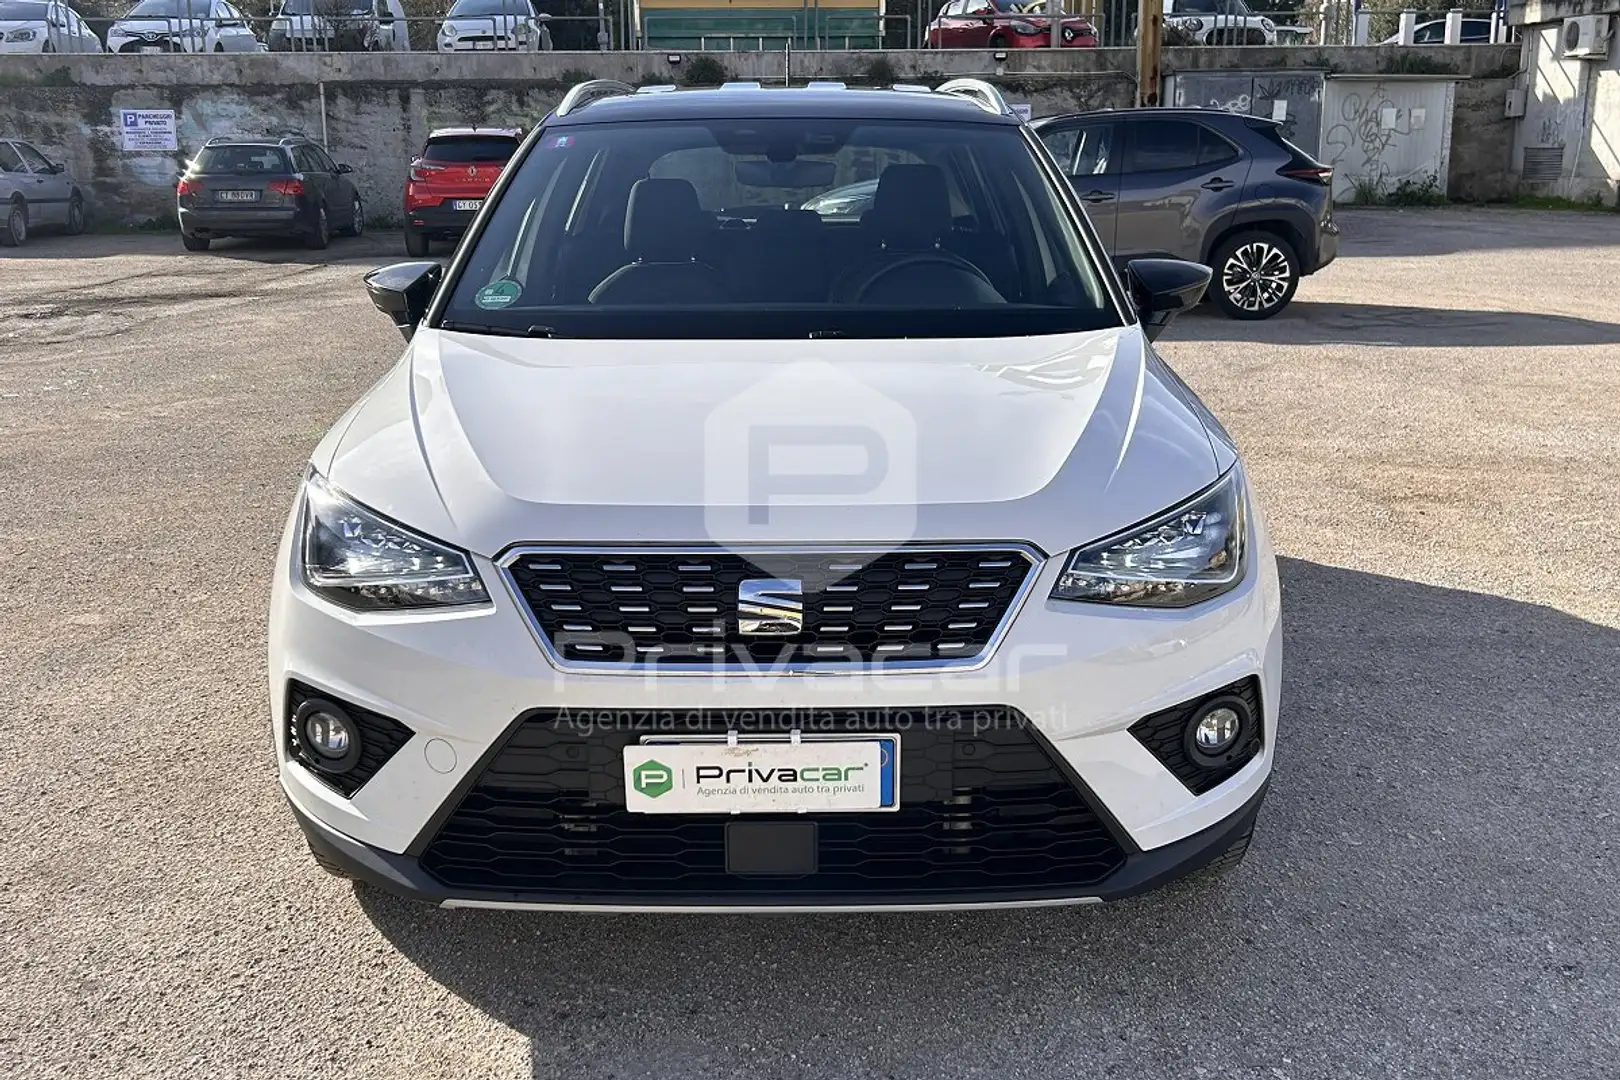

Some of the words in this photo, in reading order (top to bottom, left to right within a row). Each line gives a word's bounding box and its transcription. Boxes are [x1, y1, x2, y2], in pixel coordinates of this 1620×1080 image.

[126, 114, 135, 126] P
[695, 761, 864, 785] Privacar
[696, 785, 737, 797] Agenzia
[739, 783, 750, 795] di
[751, 783, 789, 795] vendita
[791, 784, 815, 795] auto
[816, 784, 831, 794] tra
[832, 783, 865, 796] privati
